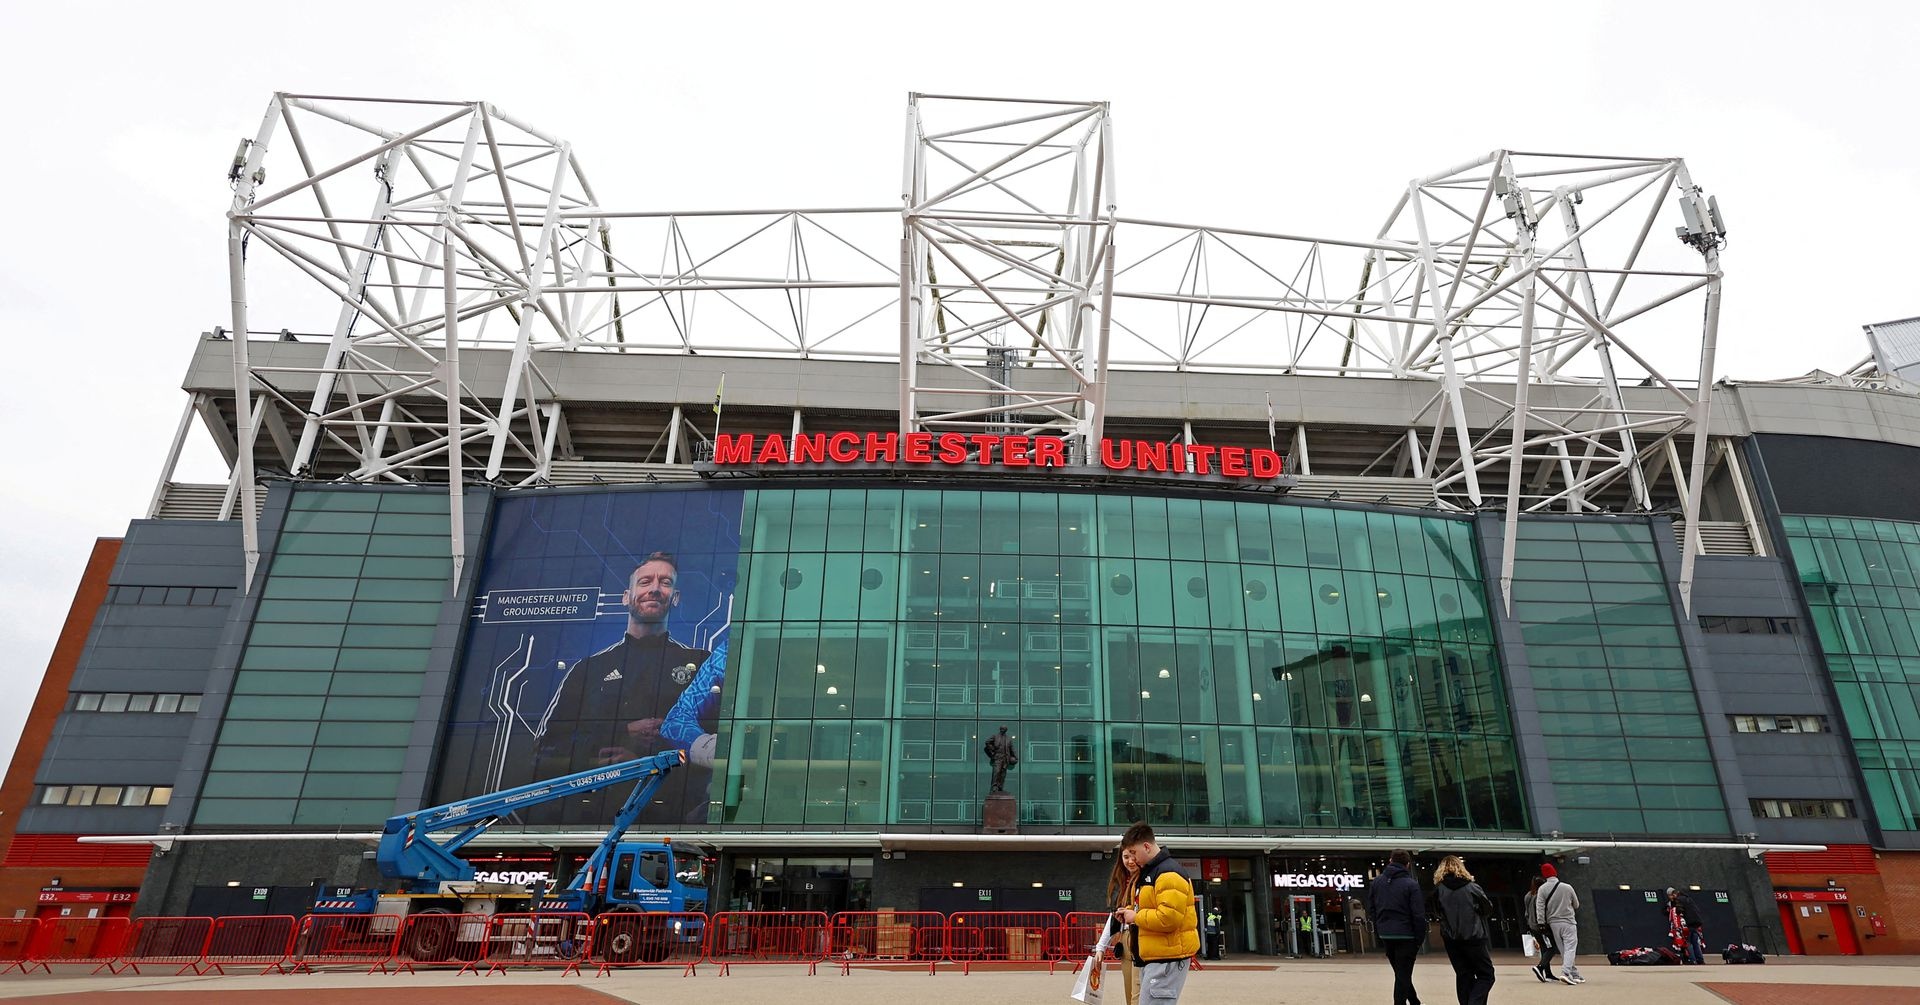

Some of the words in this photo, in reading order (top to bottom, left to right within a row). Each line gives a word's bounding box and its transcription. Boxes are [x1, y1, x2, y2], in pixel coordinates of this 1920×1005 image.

[714, 432, 1064, 468] MANCHESTER
[1101, 438, 1283, 478] UNITED
[497, 595, 554, 605] MANCHESTER
[555, 593, 588, 603] UNITED
[503, 606, 578, 616] GROUNDSKEEPER
[576, 775, 593, 787] 0345
[594, 772, 606, 782] 745
[606, 769, 621, 780] 0000
[805, 882, 814, 890] E3
[1274, 874, 1364, 887] MEGASTORE
[39, 893, 56, 901] E32
[112, 893, 131, 901] E32
